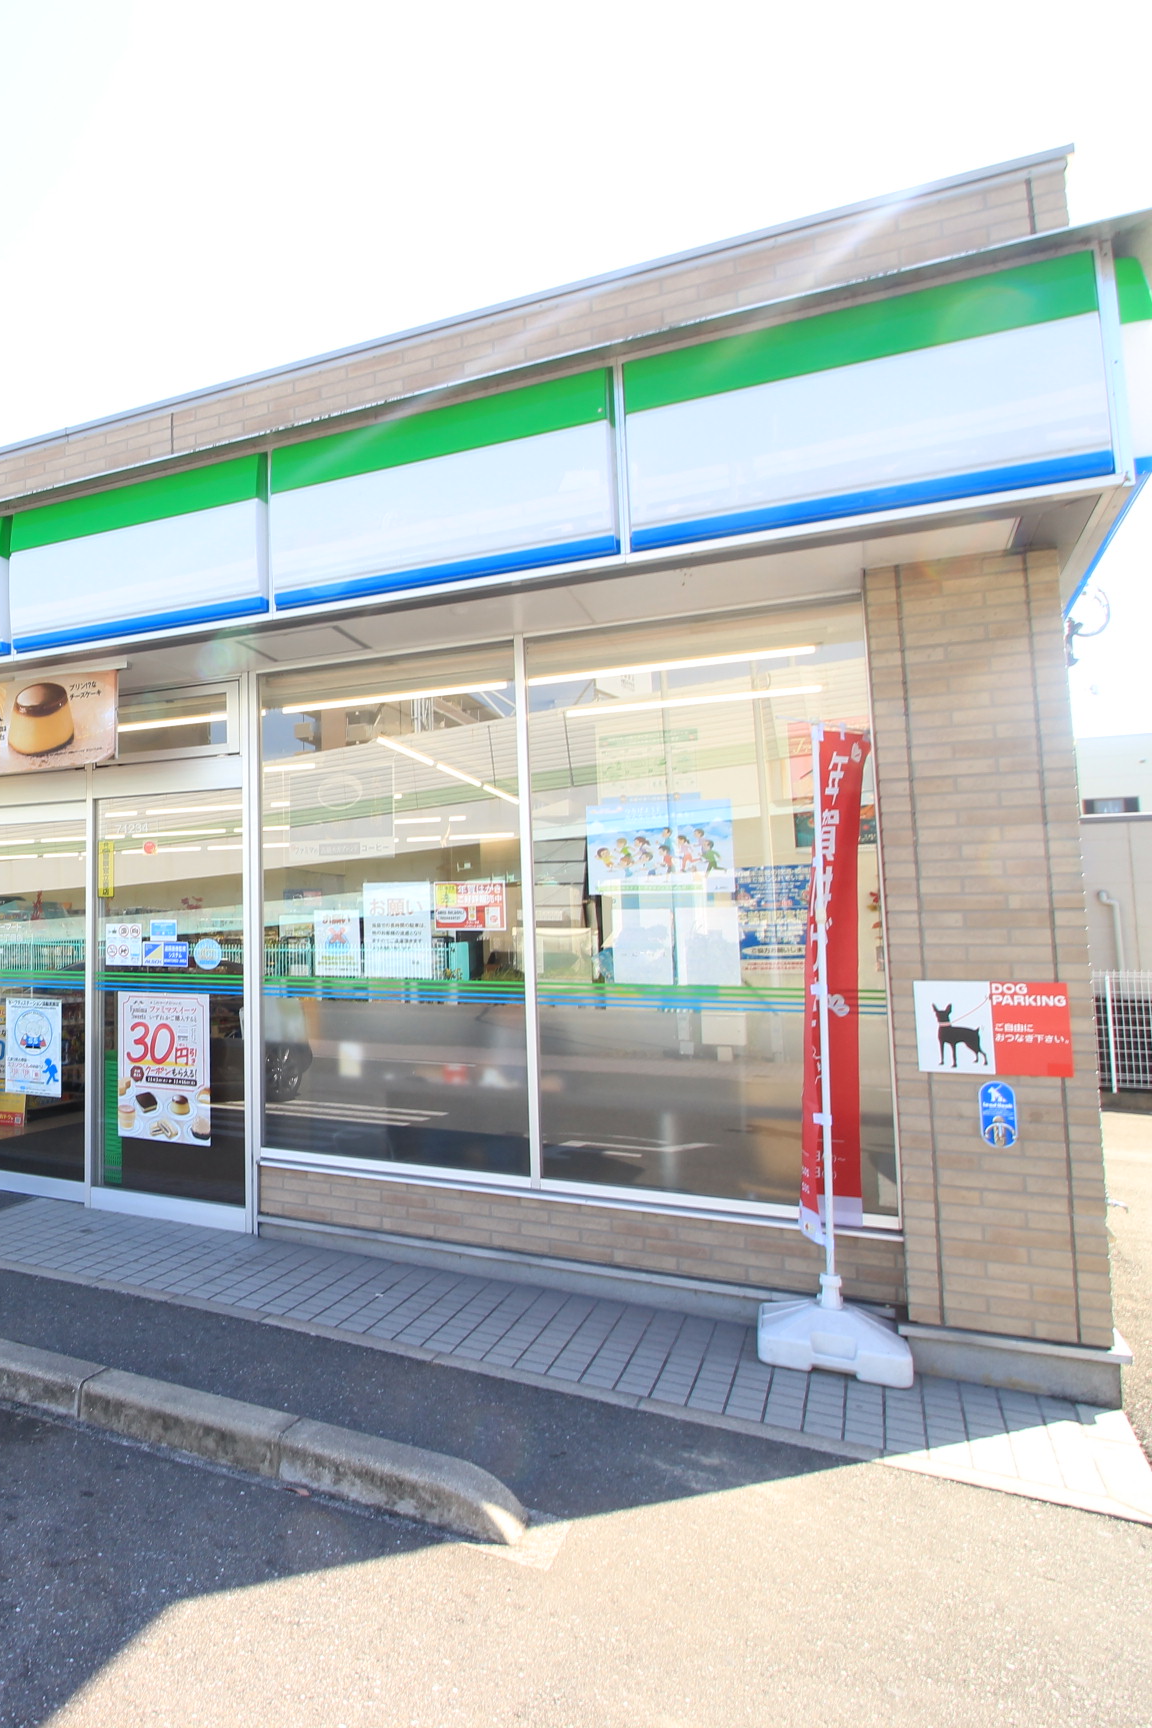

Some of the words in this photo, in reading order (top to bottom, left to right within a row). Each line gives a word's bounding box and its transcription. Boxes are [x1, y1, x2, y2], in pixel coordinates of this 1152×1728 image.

[69, 690, 102, 701] チーズケーキ
[370, 898, 423, 917] お願い
[991, 983, 1028, 995] DOG
[992, 995, 1066, 1007] PARKING
[995, 1023, 1035, 1033] ご自由に
